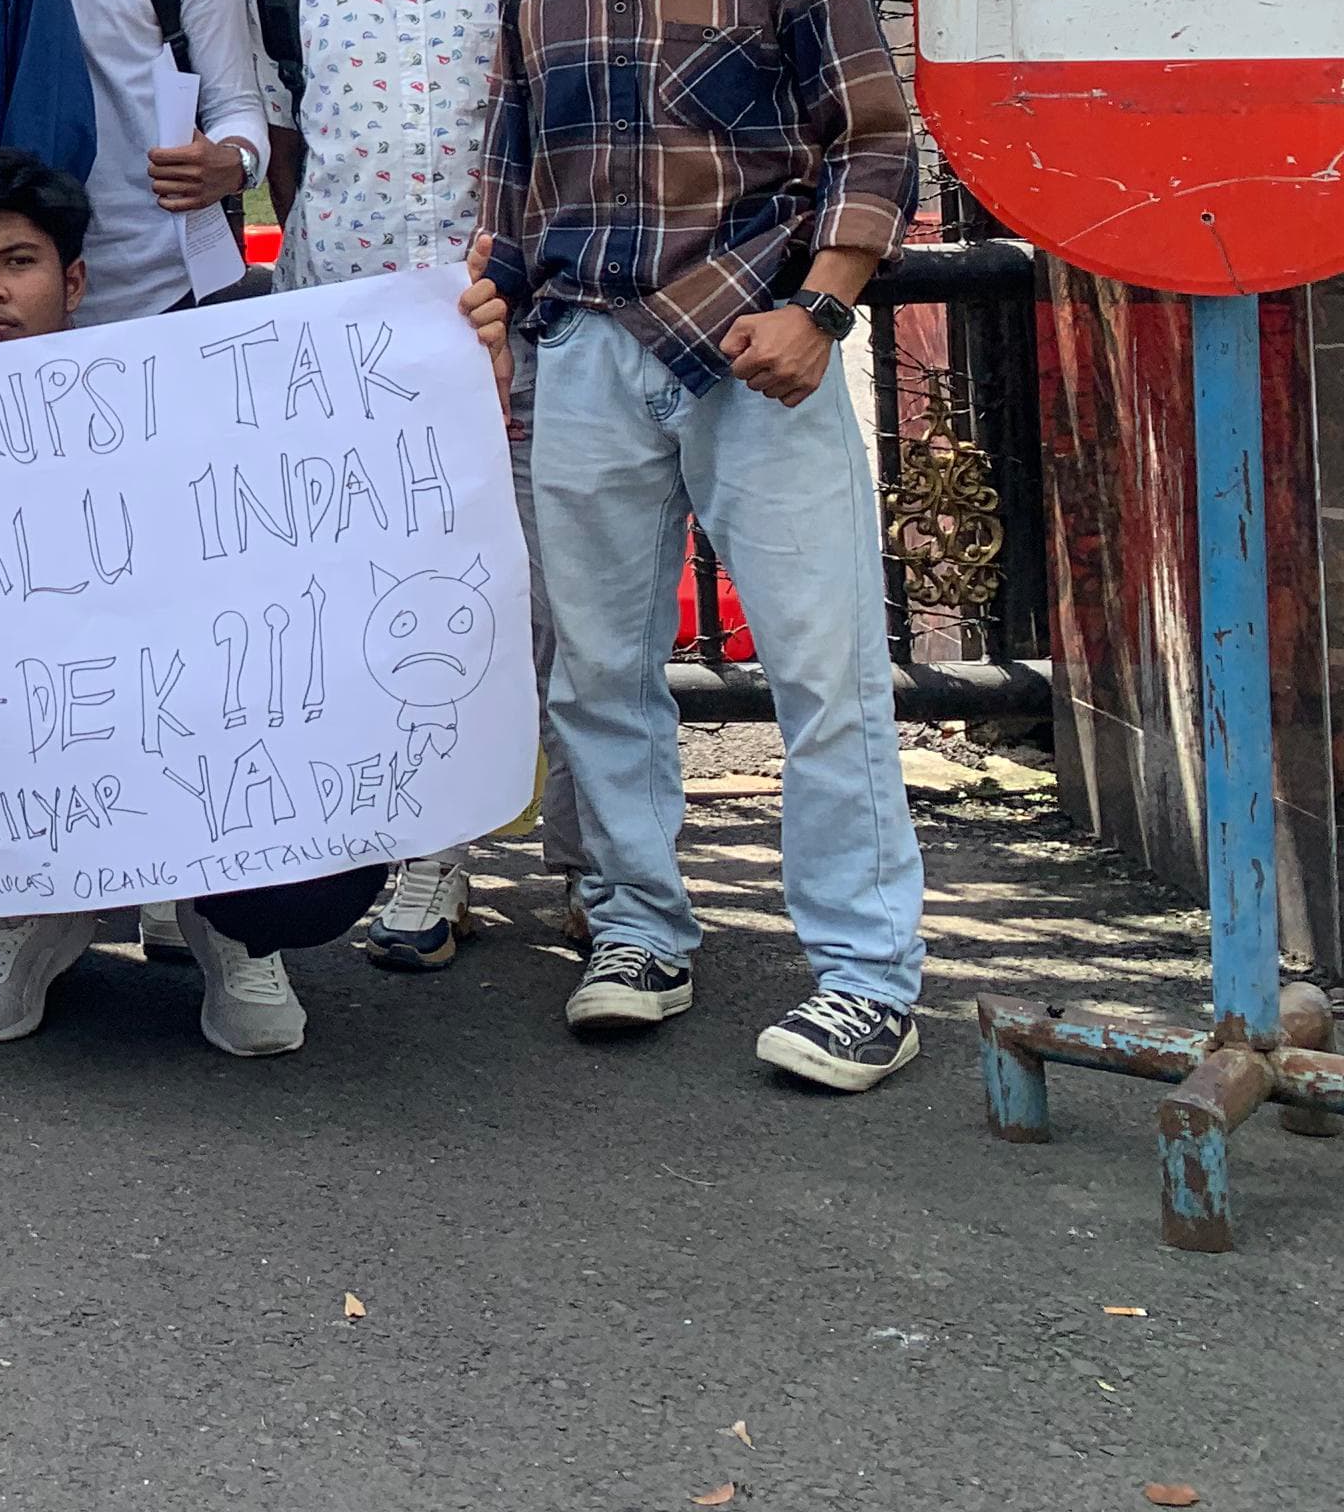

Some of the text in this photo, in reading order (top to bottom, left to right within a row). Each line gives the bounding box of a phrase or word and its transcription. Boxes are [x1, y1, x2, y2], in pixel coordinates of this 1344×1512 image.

[199, 319, 420, 429] TAK
[188, 425, 455, 561] INDAH
[163, 737, 296, 843] YA
[308, 752, 424, 824] DEK
[73, 859, 179, 900] ORANG
